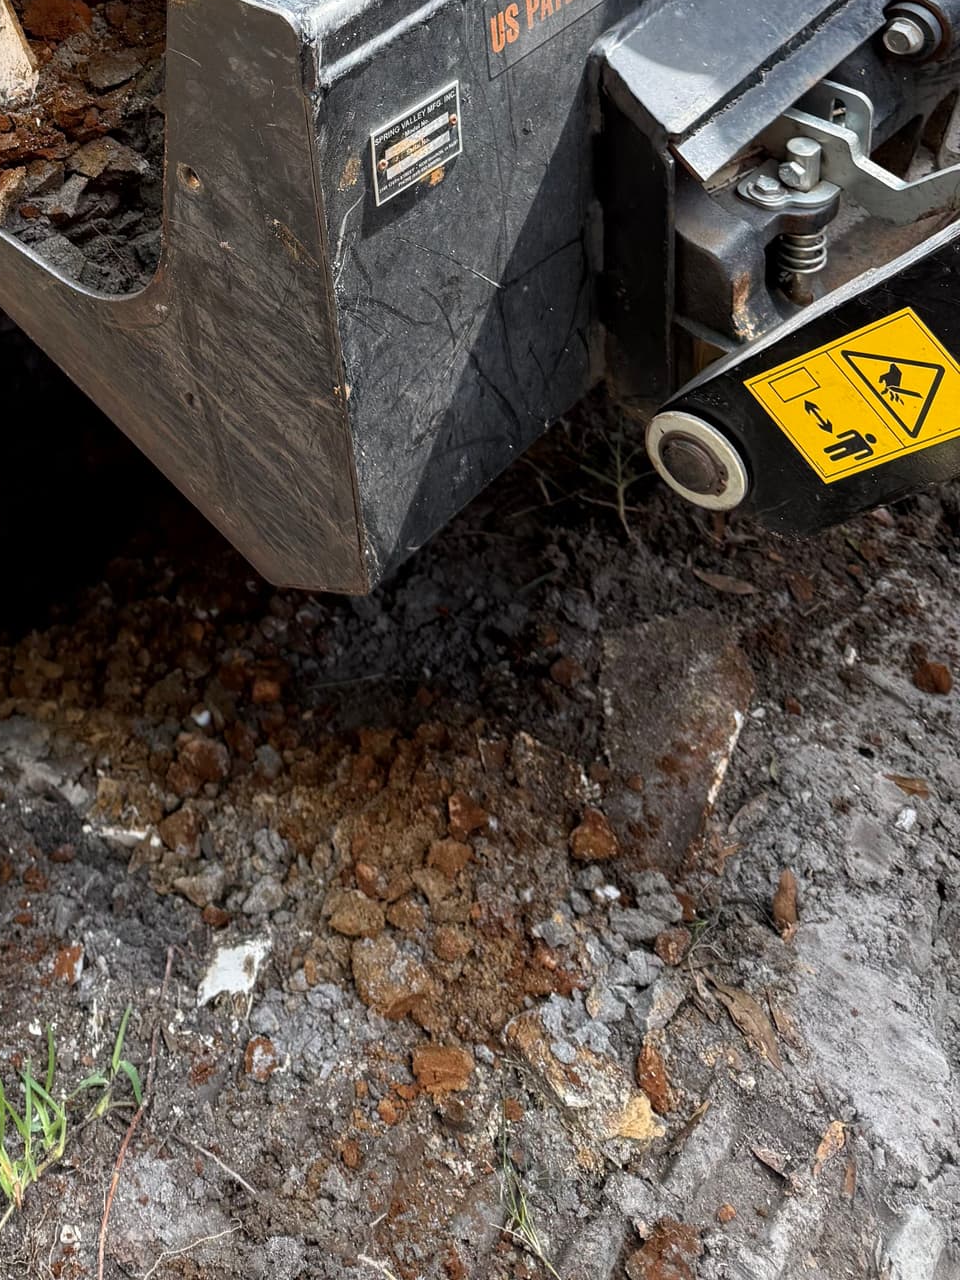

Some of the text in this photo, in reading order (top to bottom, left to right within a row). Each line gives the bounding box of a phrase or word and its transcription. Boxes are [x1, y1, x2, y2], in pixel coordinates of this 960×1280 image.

[489, 2, 520, 55] US
[374, 125, 400, 147] SPRING
[400, 109, 427, 130] VALLEY
